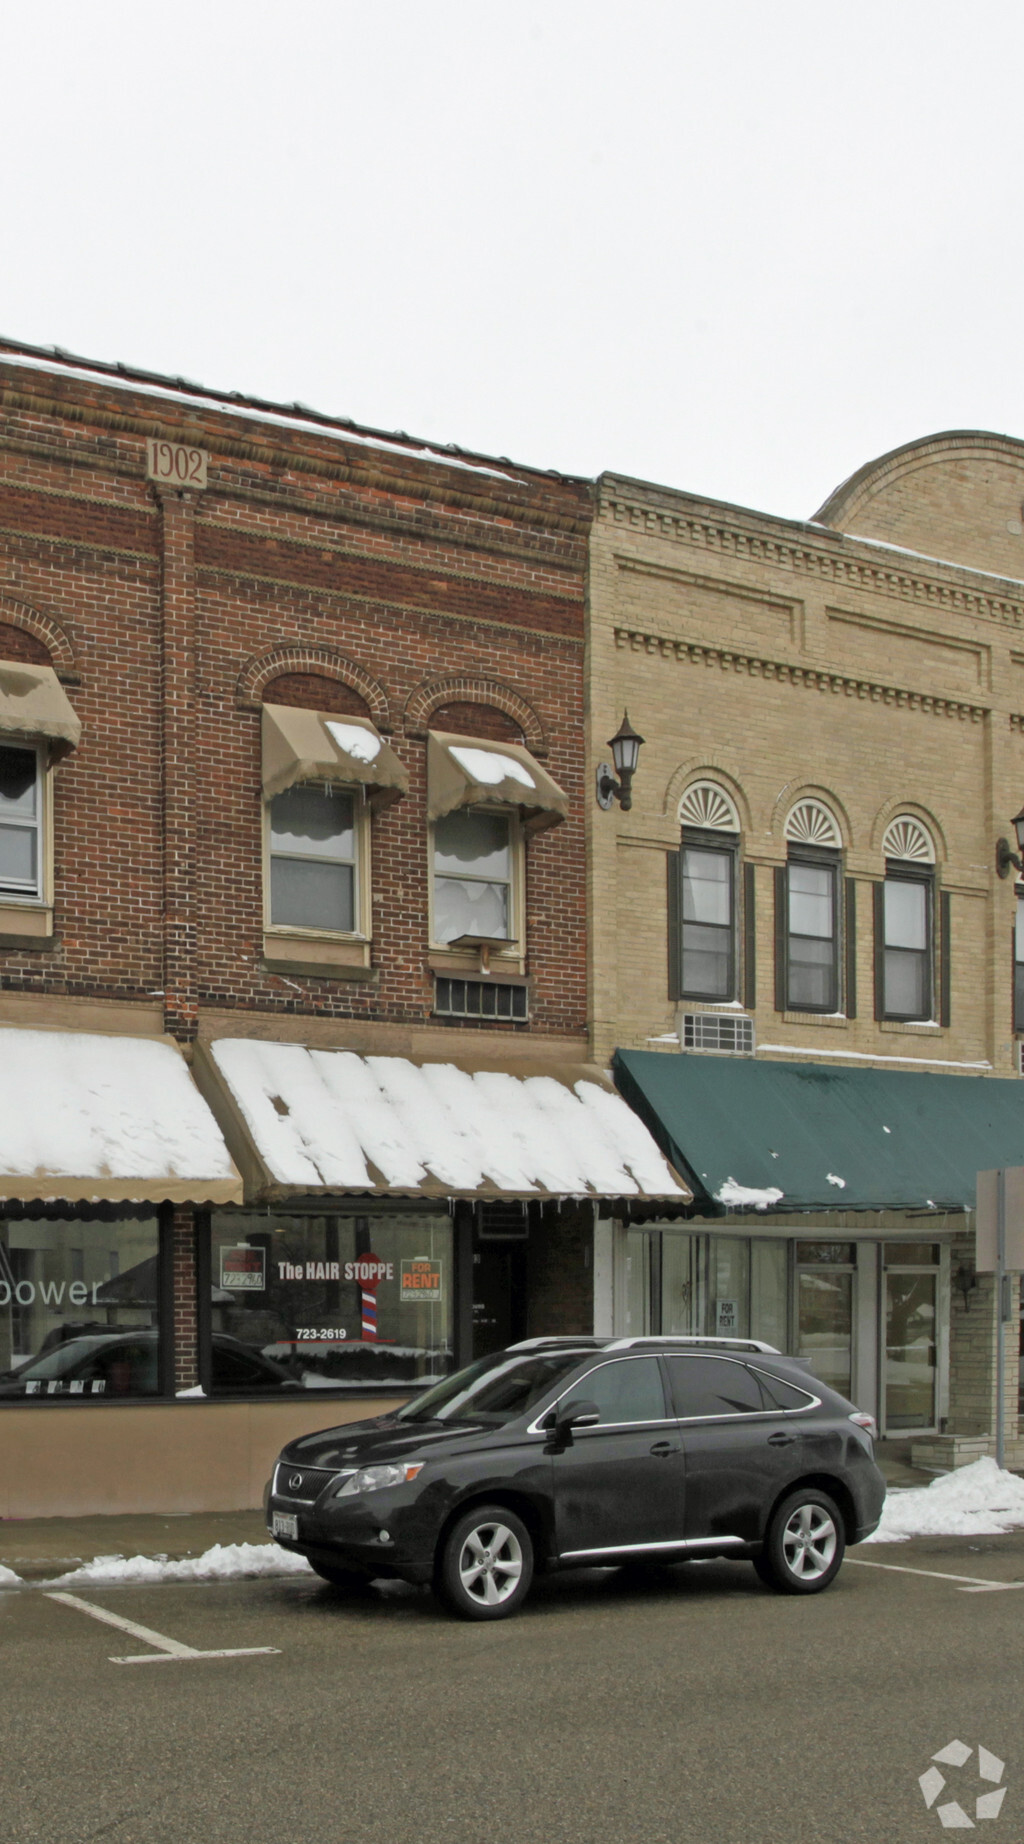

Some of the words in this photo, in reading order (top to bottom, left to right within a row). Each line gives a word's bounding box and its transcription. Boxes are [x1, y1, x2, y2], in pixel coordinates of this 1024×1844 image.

[152, 442, 203, 484] 1902
[278, 1262, 303, 1279] The
[306, 1262, 340, 1280] HAIR
[344, 1263, 394, 1280] STOPPE
[411, 1262, 431, 1273] FOR
[403, 1273, 440, 1288] RENT
[721, 1303, 733, 1314] FOR
[719, 1315, 735, 1327] RENT
[296, 1328, 347, 1339] 723-2619
